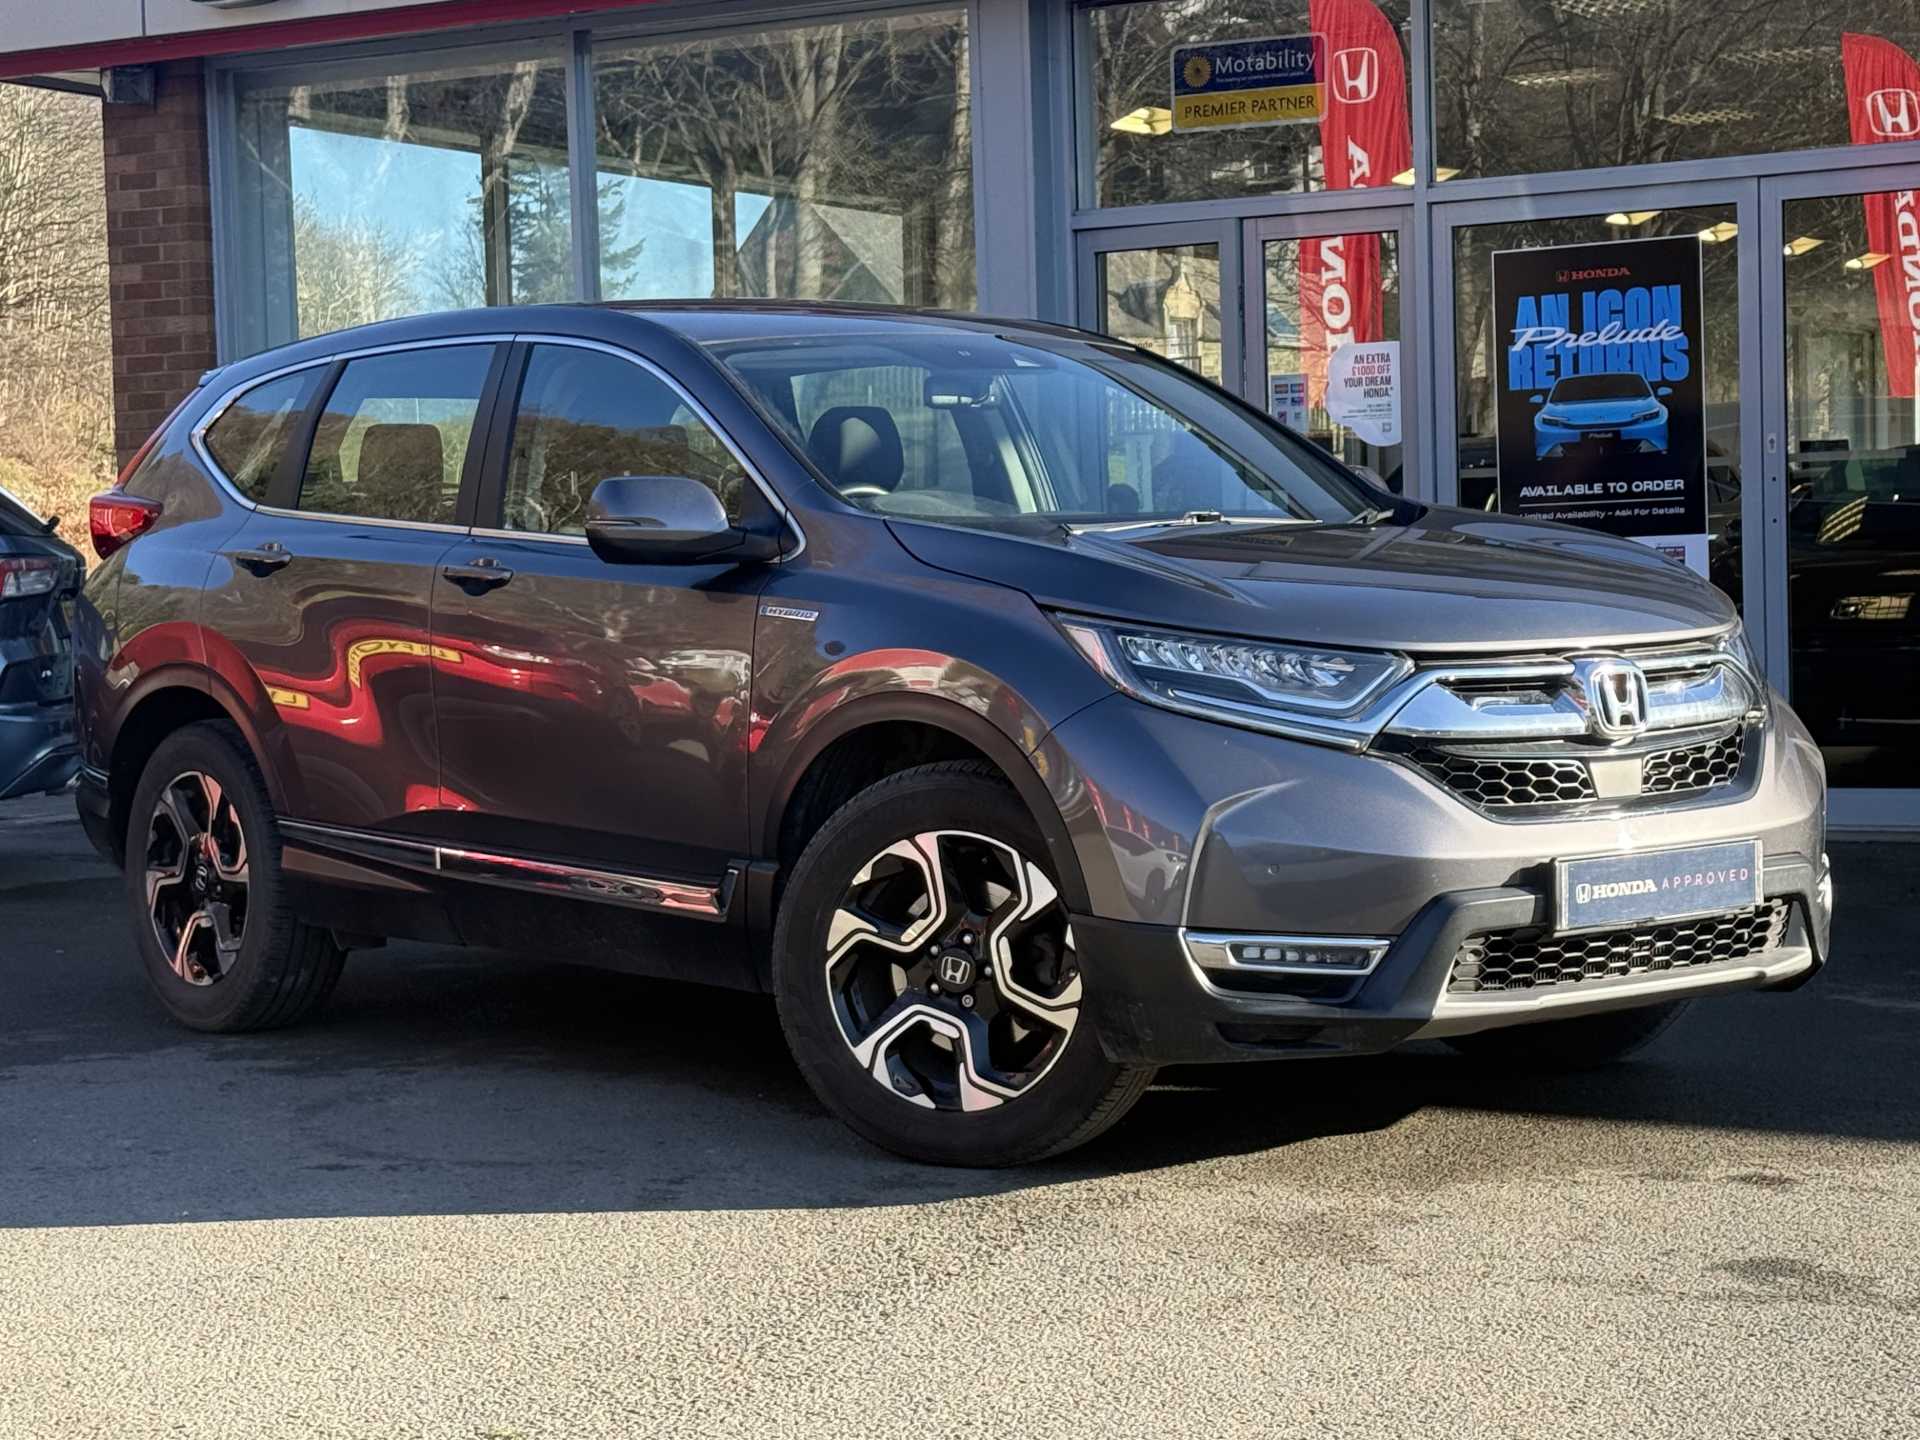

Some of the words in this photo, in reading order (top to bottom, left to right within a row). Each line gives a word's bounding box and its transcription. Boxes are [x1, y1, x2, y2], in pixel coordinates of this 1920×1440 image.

[1215, 48, 1316, 75] Motability
[1184, 101, 1246, 119] PREMIER
[1251, 95, 1315, 113] PARTNER
[1571, 267, 1631, 280] HONDA
[1515, 293, 1569, 342] AN
[1582, 284, 1681, 338] ICON
[1510, 319, 1684, 351] Prelude
[1354, 354, 1364, 364] AN
[1366, 352, 1391, 364] EXTRA
[1508, 335, 1689, 391] RETURNS
[1377, 364, 1391, 374] OFF
[1344, 377, 1364, 388] YOUR
[1365, 375, 1392, 387] DREAM
[1520, 483, 1603, 498] AVAILABLE
[1607, 481, 1627, 493] TO
[1632, 479, 1685, 492] ORDER
[1555, 510, 1605, 520] Availability
[1615, 508, 1630, 517] Ask
[1652, 506, 1685, 515] Details
[1592, 879, 1657, 899] HONDA
[1661, 868, 1749, 890] APPROVED
